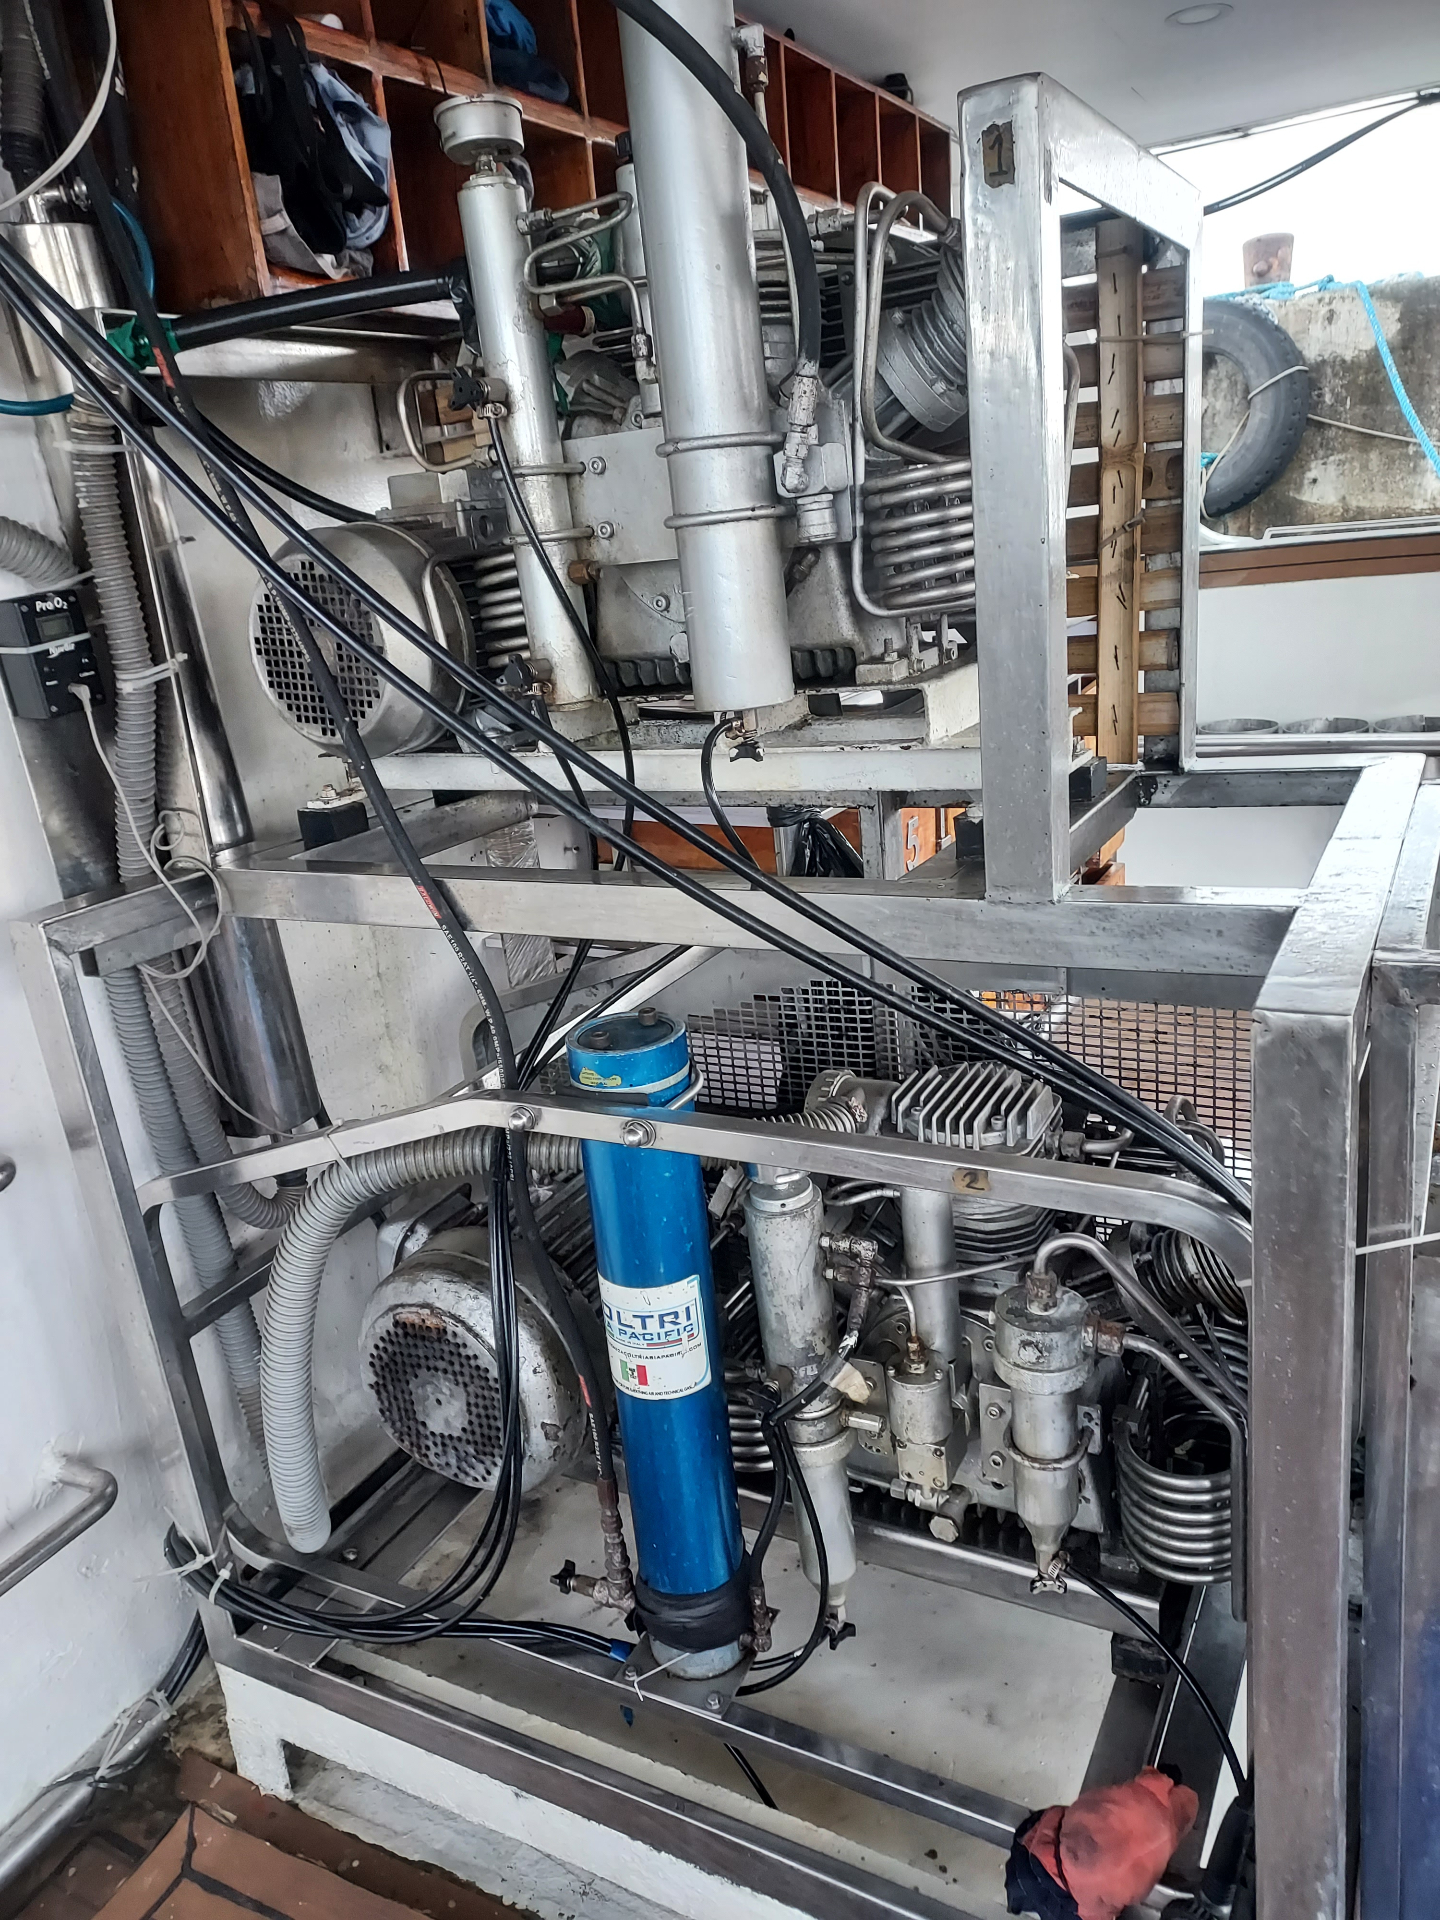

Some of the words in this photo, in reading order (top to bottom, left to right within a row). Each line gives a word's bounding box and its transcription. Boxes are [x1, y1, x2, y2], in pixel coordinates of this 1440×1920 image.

[989, 133, 1008, 176] 1
[908, 816, 919, 871] 5
[963, 1171, 985, 1190] 2
[603, 1302, 691, 1330] OLTRI
[618, 1323, 694, 1341] PACIFIC
